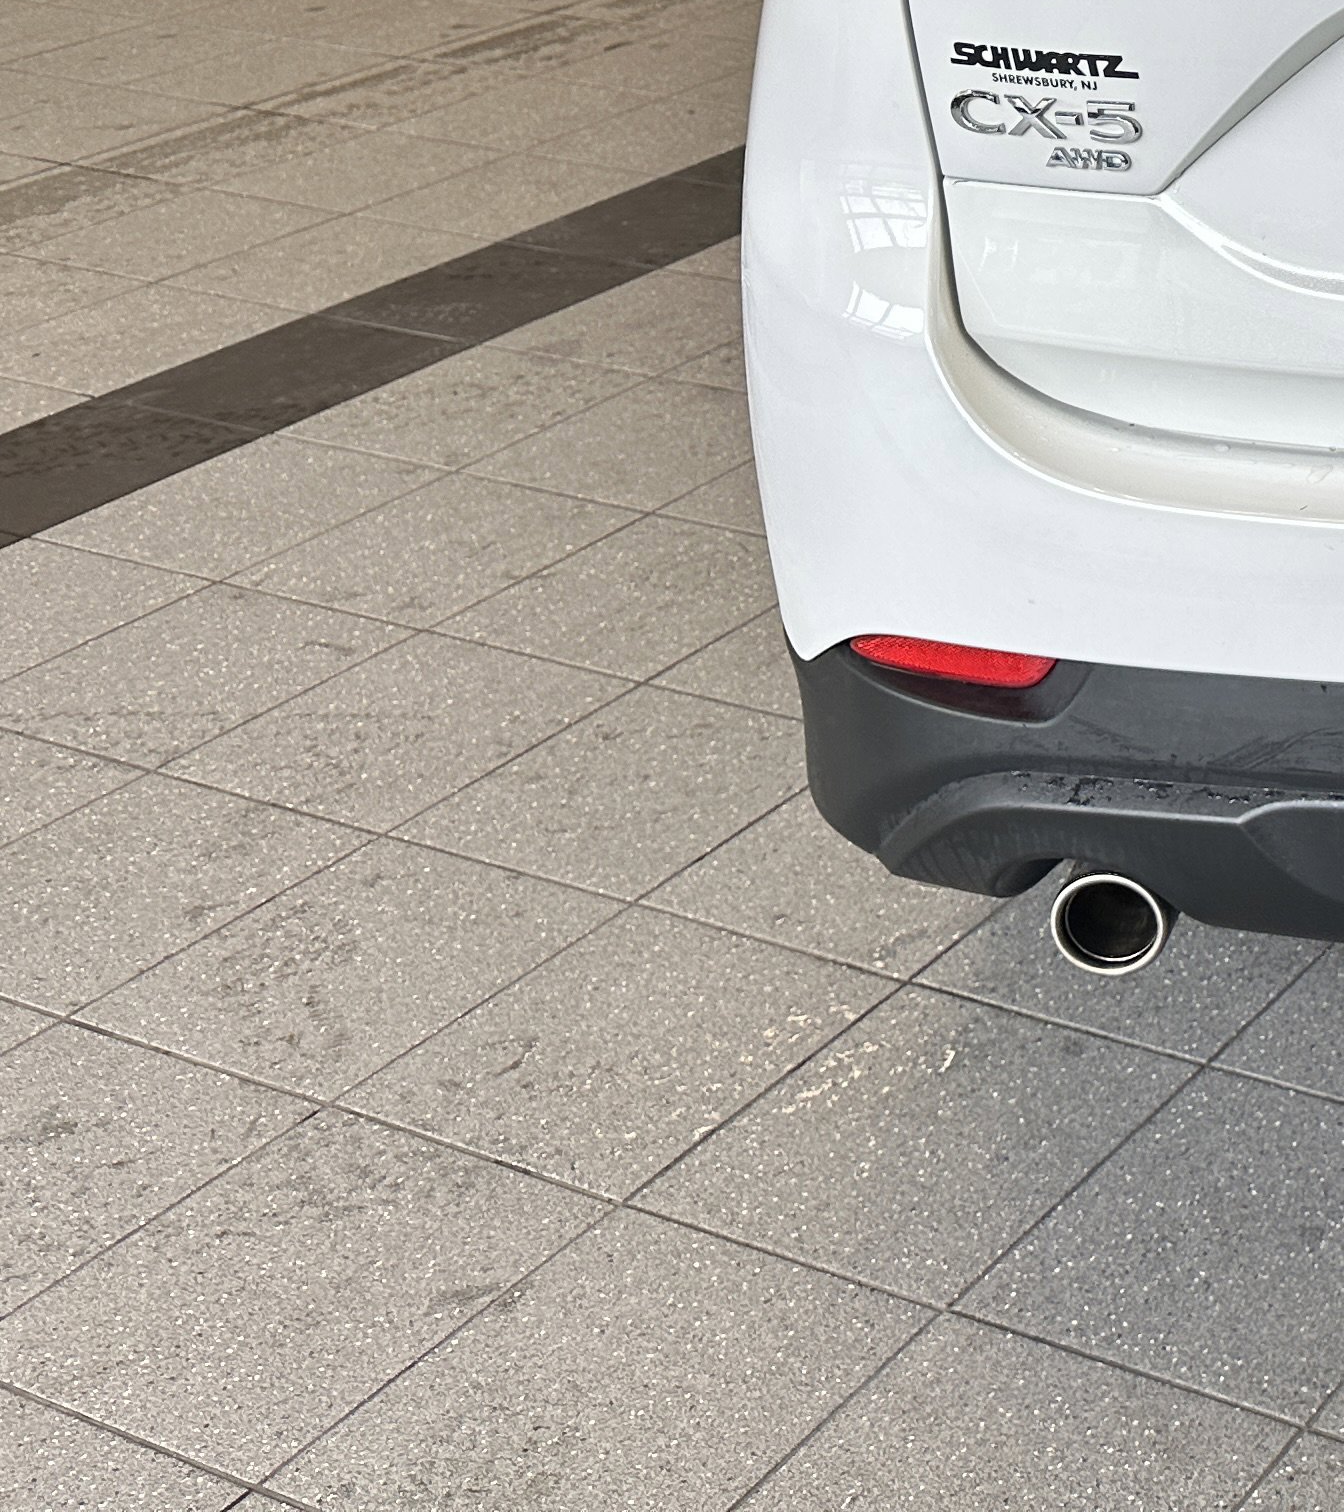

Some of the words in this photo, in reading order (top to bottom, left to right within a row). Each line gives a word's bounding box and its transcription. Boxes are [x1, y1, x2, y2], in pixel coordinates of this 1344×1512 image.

[950, 41, 1140, 79] SCHWARTZ
[992, 72, 1078, 91] SHREWSBURY,
[1080, 80, 1098, 91] NJ
[950, 89, 1143, 145] CX-5
[1046, 146, 1133, 172] AWD
